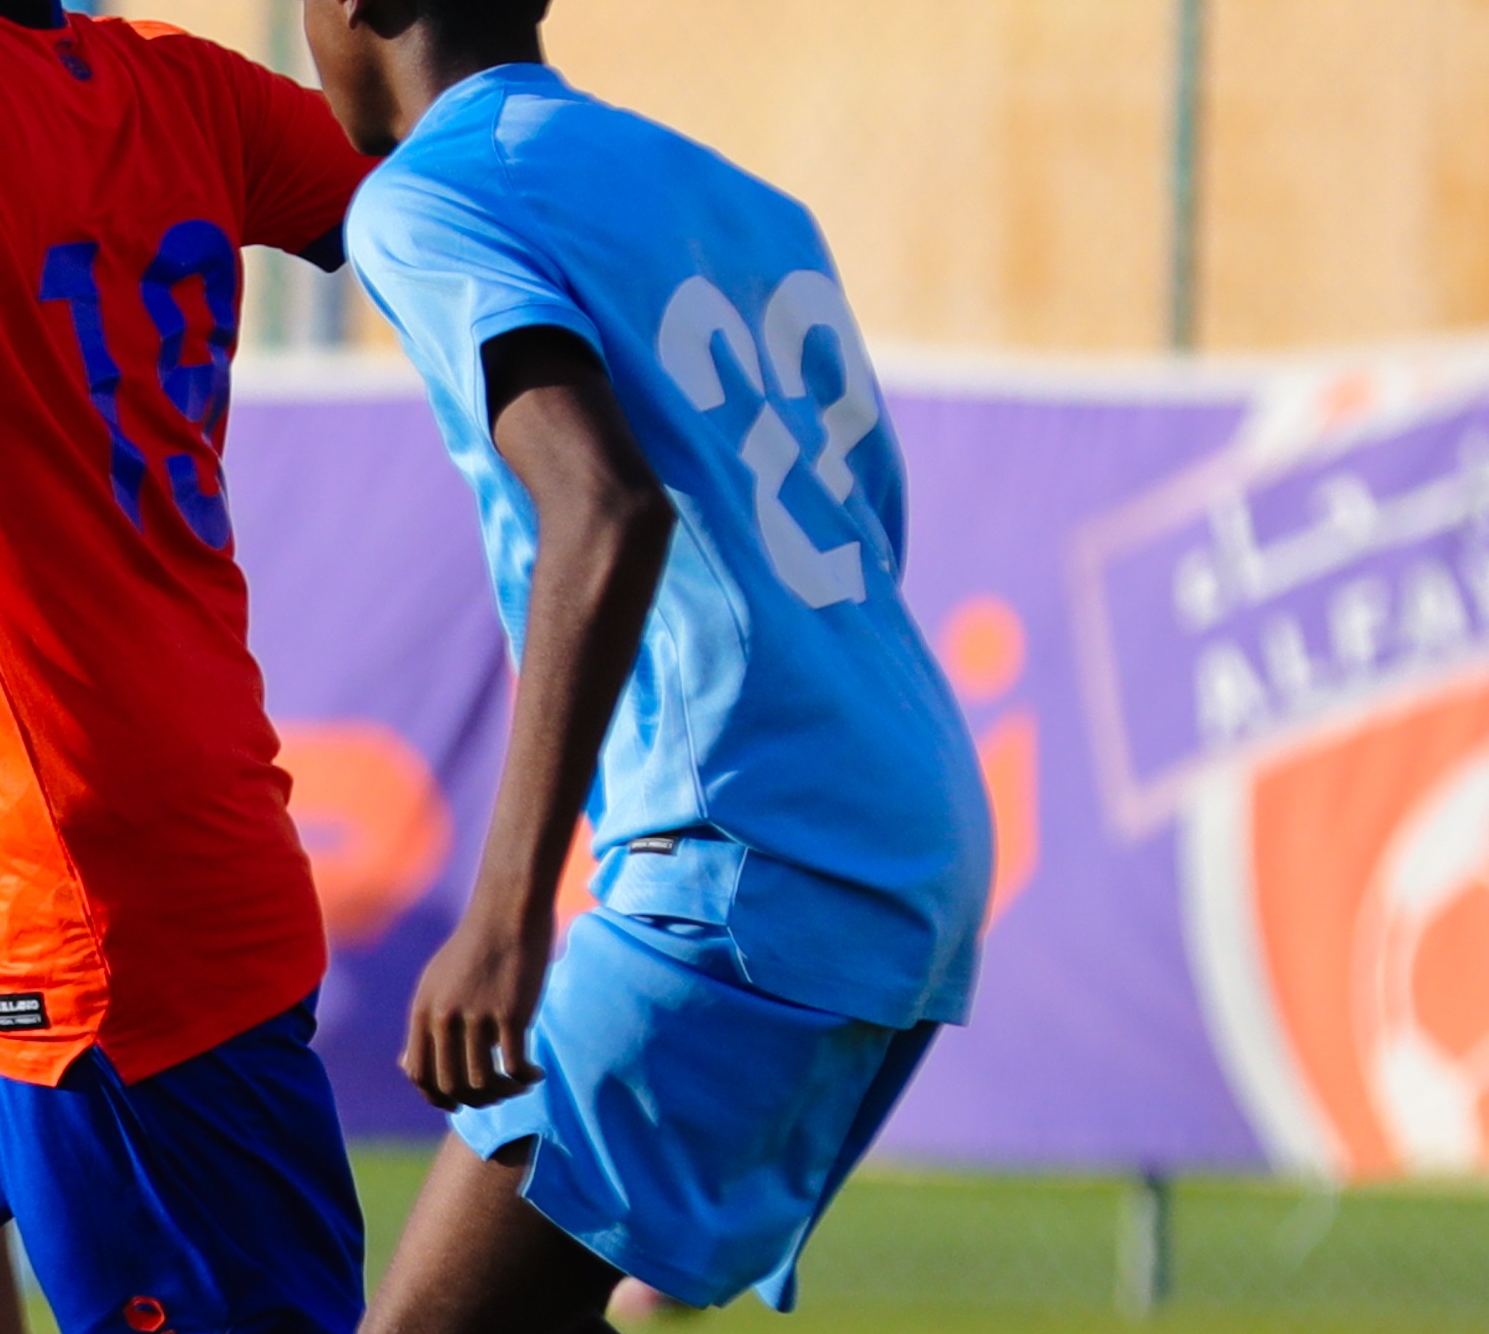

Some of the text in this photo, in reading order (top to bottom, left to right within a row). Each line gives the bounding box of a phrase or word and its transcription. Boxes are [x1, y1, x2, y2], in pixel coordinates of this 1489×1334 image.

[38, 218, 237, 551] 19
[654, 267, 881, 610] 22
[1194, 552, 1489, 747] ALFA
